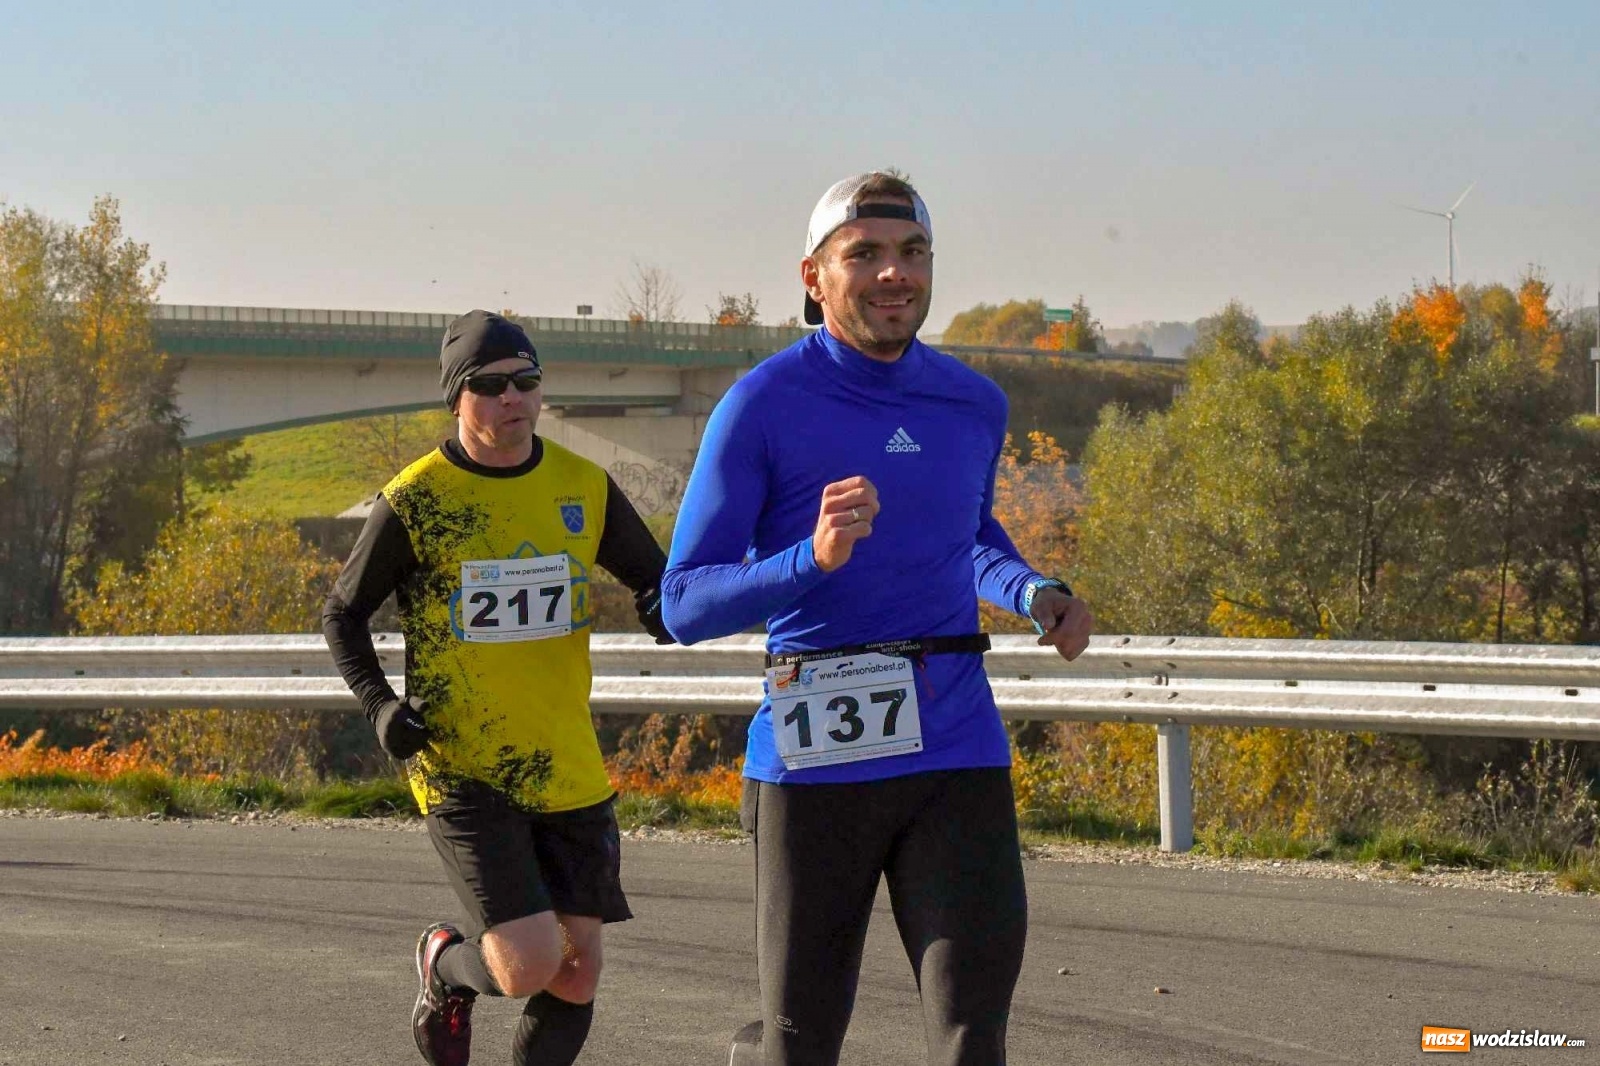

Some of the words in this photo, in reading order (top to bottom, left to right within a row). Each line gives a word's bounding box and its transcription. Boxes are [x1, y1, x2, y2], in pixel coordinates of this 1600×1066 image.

[886, 443, 921, 453] adidas
[504, 565, 565, 576] www.personalbest.pl
[469, 585, 565, 627] 217
[786, 651, 843, 664] performance
[818, 661, 907, 680] www.personalbest.pl
[784, 688, 907, 748] 137
